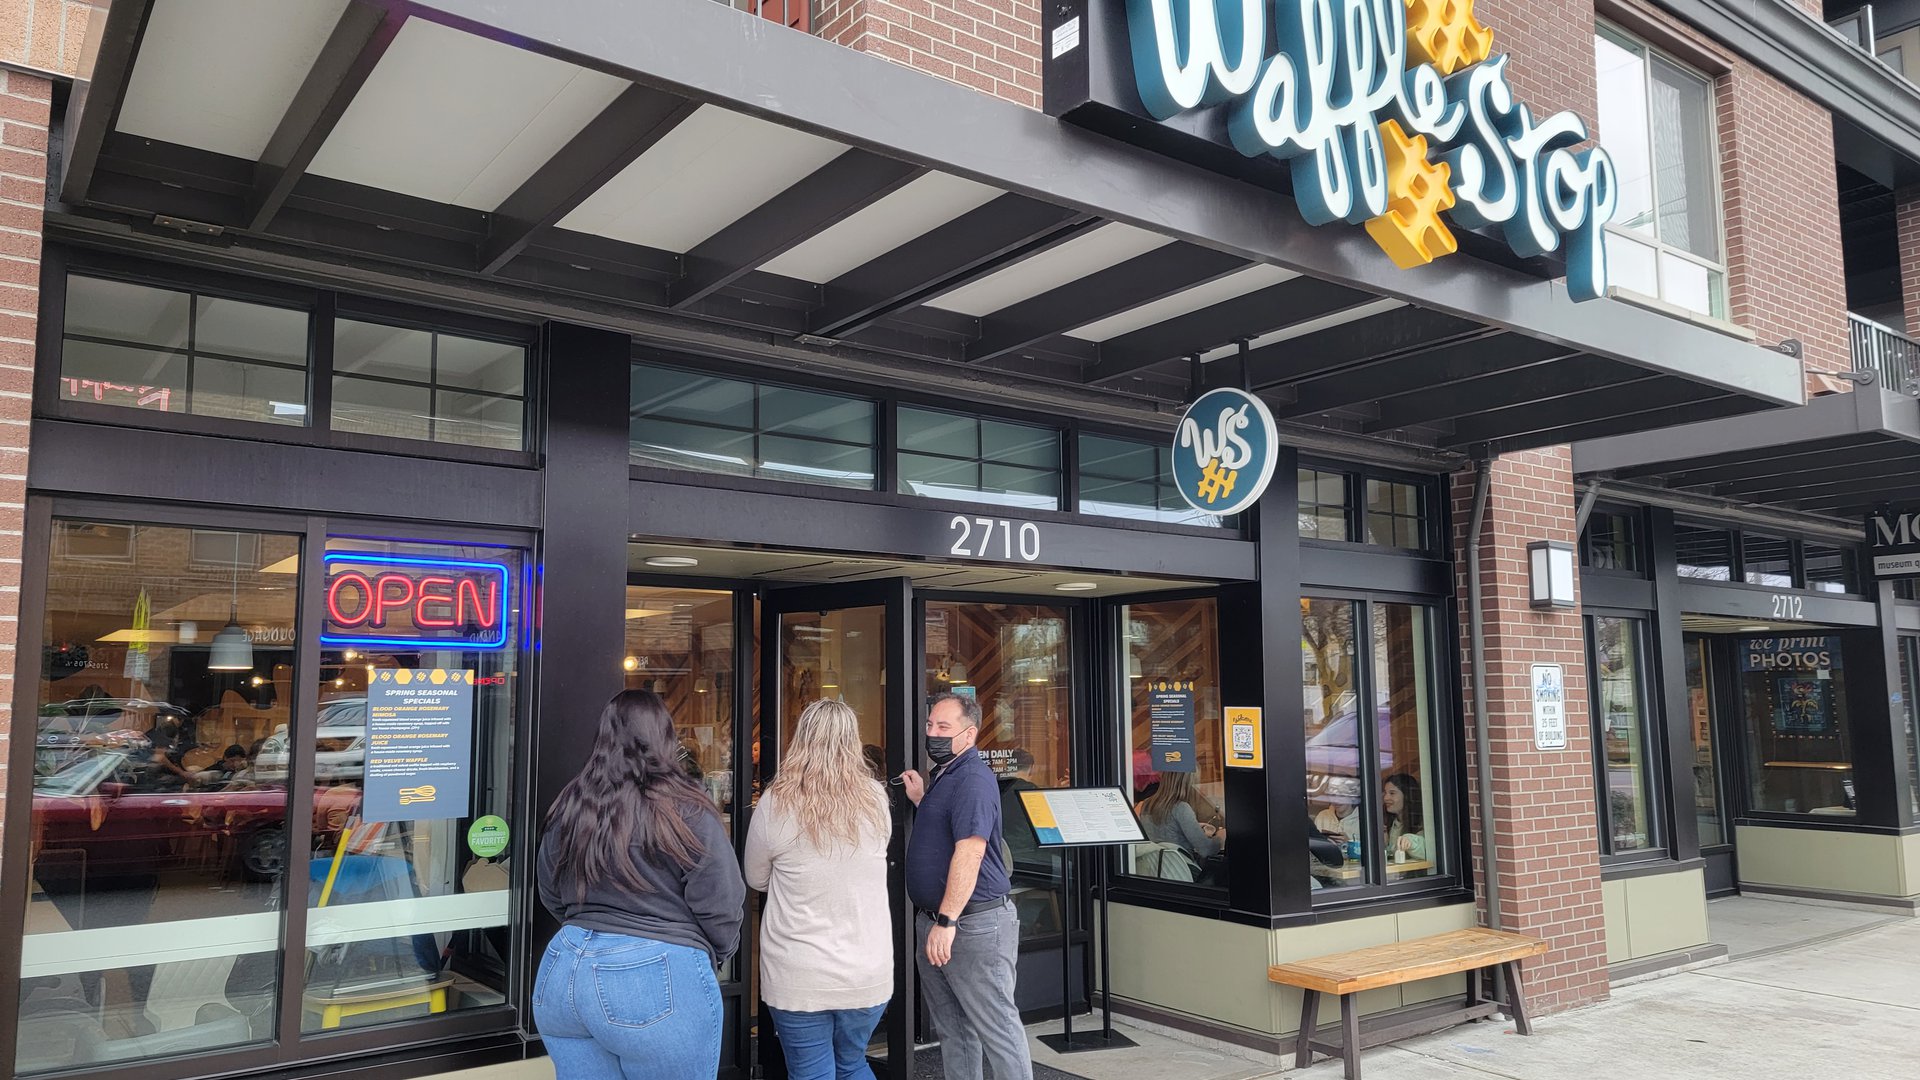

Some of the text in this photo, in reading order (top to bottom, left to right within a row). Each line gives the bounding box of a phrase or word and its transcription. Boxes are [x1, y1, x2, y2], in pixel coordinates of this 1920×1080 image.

[1147, 0, 1465, 219] Waffle
[1457, 53, 1618, 298] Stop
[1181, 403, 1252, 468] WS
[950, 515, 1040, 561] 2710
[1878, 560, 1913, 570] museum
[328, 573, 497, 627] OPEN
[1772, 594, 1803, 618] 2712
[1750, 636, 1826, 652] we print
[1750, 652, 1831, 668] PHOTOS
[1542, 673, 1552, 686] NO
[1536, 689, 1560, 702] SMOKING
[1542, 718, 1558, 728] 25 FEET
[1545, 730, 1563, 740] BUILDING
[978, 749, 1014, 759] EN DAILY
[472, 837, 506, 845] FAVORITE
